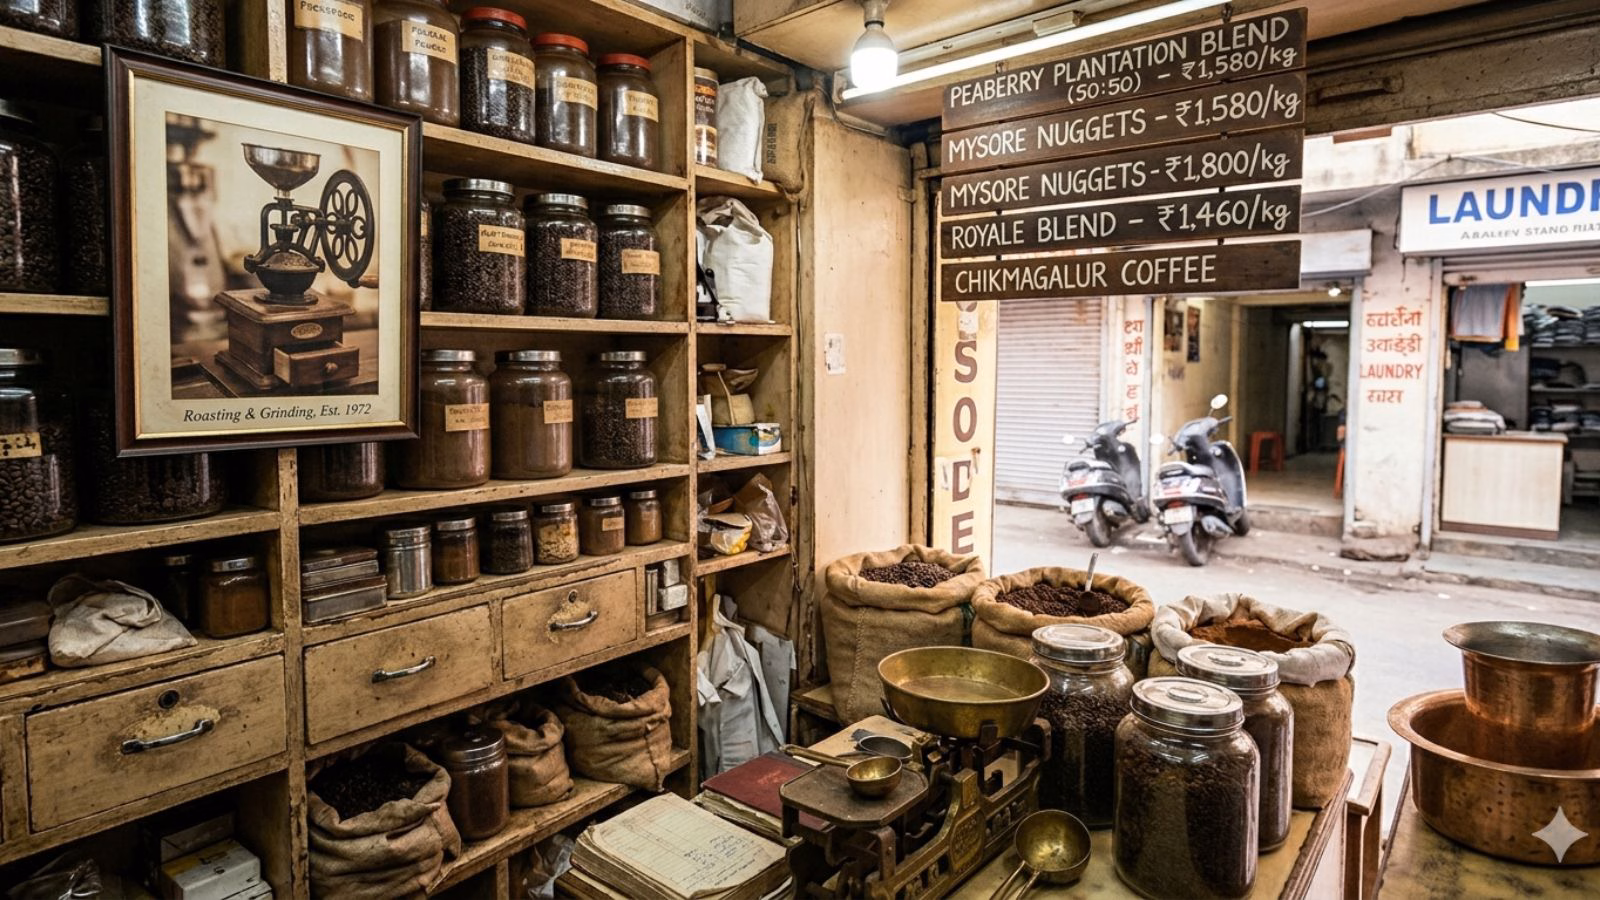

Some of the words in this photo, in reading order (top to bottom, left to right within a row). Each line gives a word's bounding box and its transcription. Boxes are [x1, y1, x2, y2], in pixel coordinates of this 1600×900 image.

[950, 67, 1044, 108] PEABERRY
[1054, 36, 1187, 86] PLANTATION
[1201, 16, 1289, 56] BLEND
[1068, 71, 1141, 104] (50:50)
[1181, 45, 1297, 80] ₹1,580/kg
[949, 128, 1026, 163] MYSORE
[1037, 108, 1147, 149] NUGGETS
[1175, 84, 1301, 127] ₹1,580/kg
[950, 175, 1030, 208] MYSORE
[952, 220, 1025, 250] ROYALE
[1037, 211, 1117, 243] BLEND
[1157, 193, 1291, 232] ₹1,460/kg
[955, 261, 1108, 293] CHIKMAGALUR
[1121, 254, 1217, 286] COFFEE
[1359, 363, 1424, 379] LAUNDRY
[183, 408, 242, 424] Roasting
[244, 407, 256, 420] &
[260, 406, 317, 420] Grinding,
[319, 404, 341, 417] Est.
[345, 403, 372, 415] 1972
[951, 302, 978, 554] SODE
